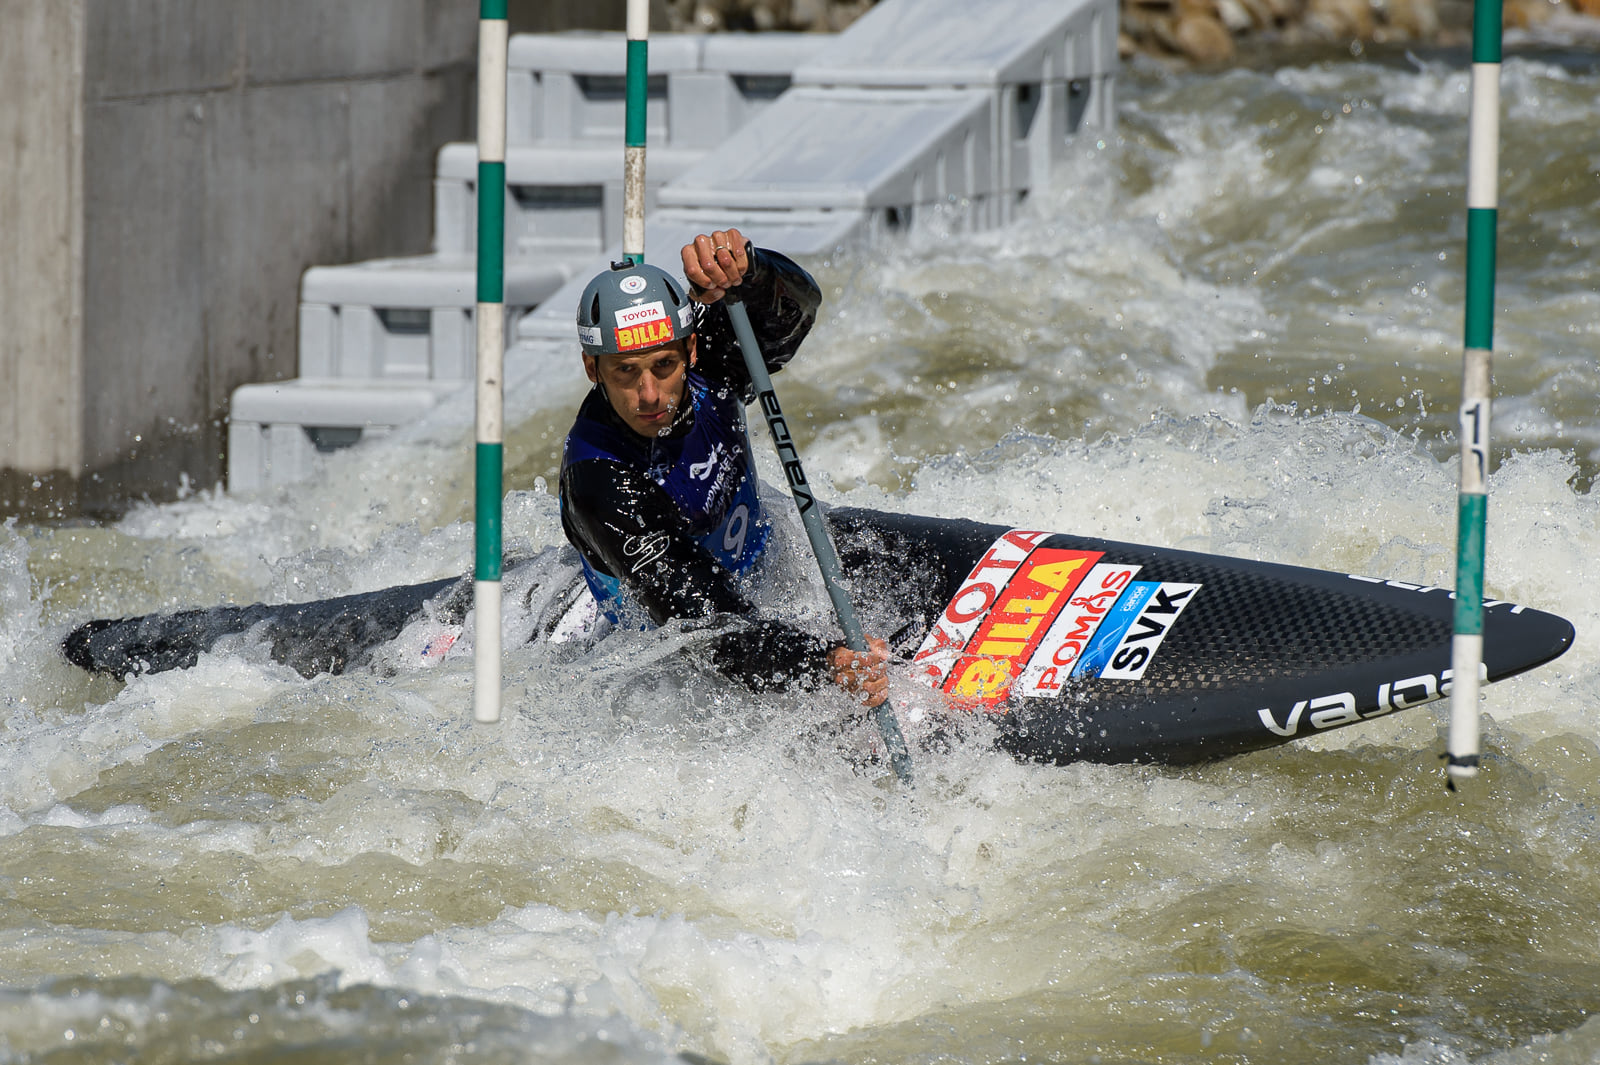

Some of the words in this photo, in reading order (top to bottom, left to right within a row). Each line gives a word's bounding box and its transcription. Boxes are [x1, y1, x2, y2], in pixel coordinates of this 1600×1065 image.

[618, 321, 670, 347] BILLA
[622, 308, 659, 322] TOYOTA
[724, 504, 749, 563] 9
[913, 531, 1050, 688] YOTA
[953, 557, 1088, 698] BILLA
[1112, 587, 1194, 671] SVK
